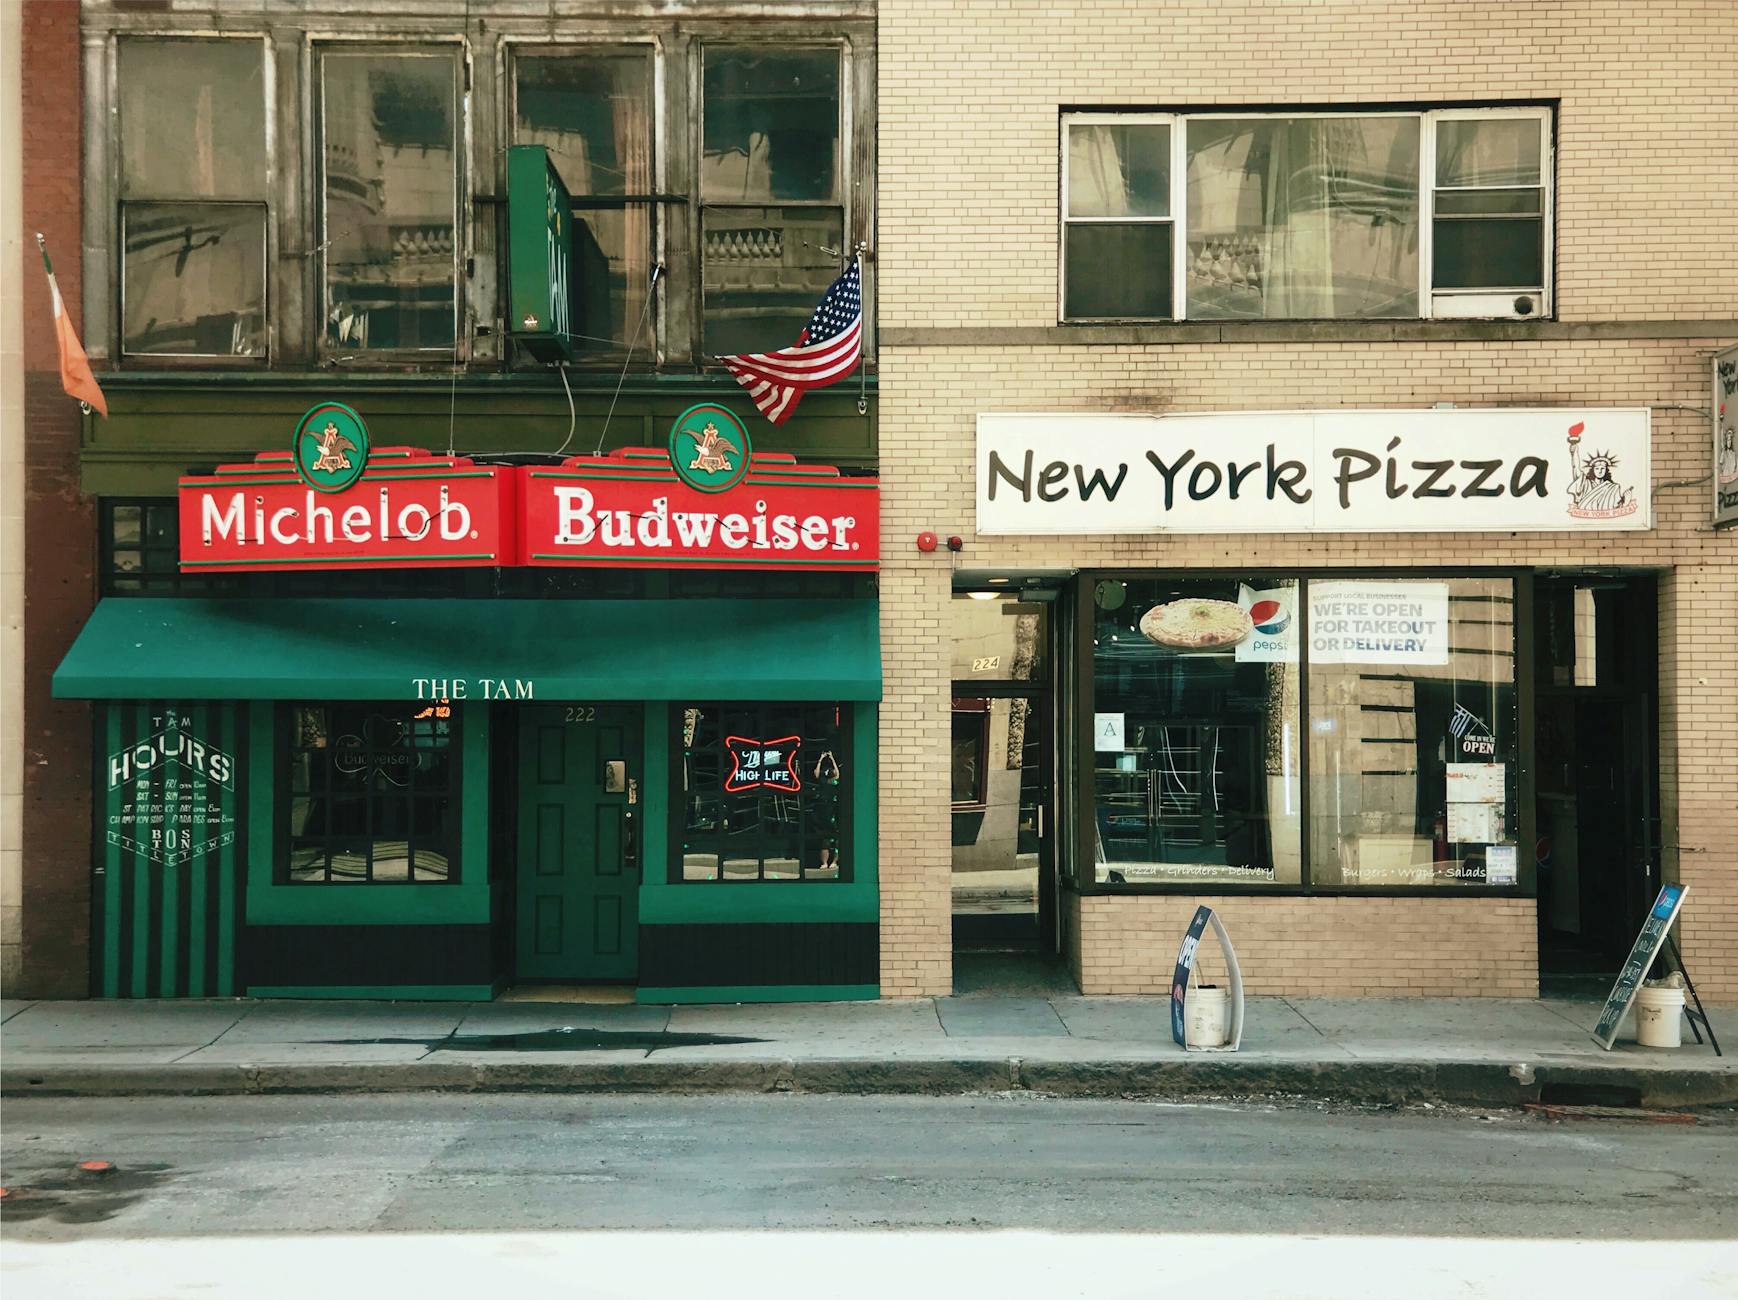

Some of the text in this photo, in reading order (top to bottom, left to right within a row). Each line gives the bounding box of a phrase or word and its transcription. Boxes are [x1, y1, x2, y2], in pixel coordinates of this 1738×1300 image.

[988, 436, 1549, 510] New York Pizza
[1314, 602, 1423, 617] WE'RE OPEN
[1314, 620, 1437, 635] FOR TAKEOUT
[1312, 637, 1427, 652] OR DELIVERY
[974, 657, 998, 670] 224
[412, 679, 534, 699] THE TAM
[564, 706, 595, 722] 222
[152, 717, 192, 728] TAM
[1103, 721, 1117, 736] A
[1462, 741, 1495, 755] OPEN
[111, 734, 230, 787] HOURS
[764, 769, 790, 781] LIFE
[1167, 865, 1218, 876] Grinders
[1228, 865, 1275, 880] Delivery
[1341, 866, 1487, 881] Burgers Wraps Salads
